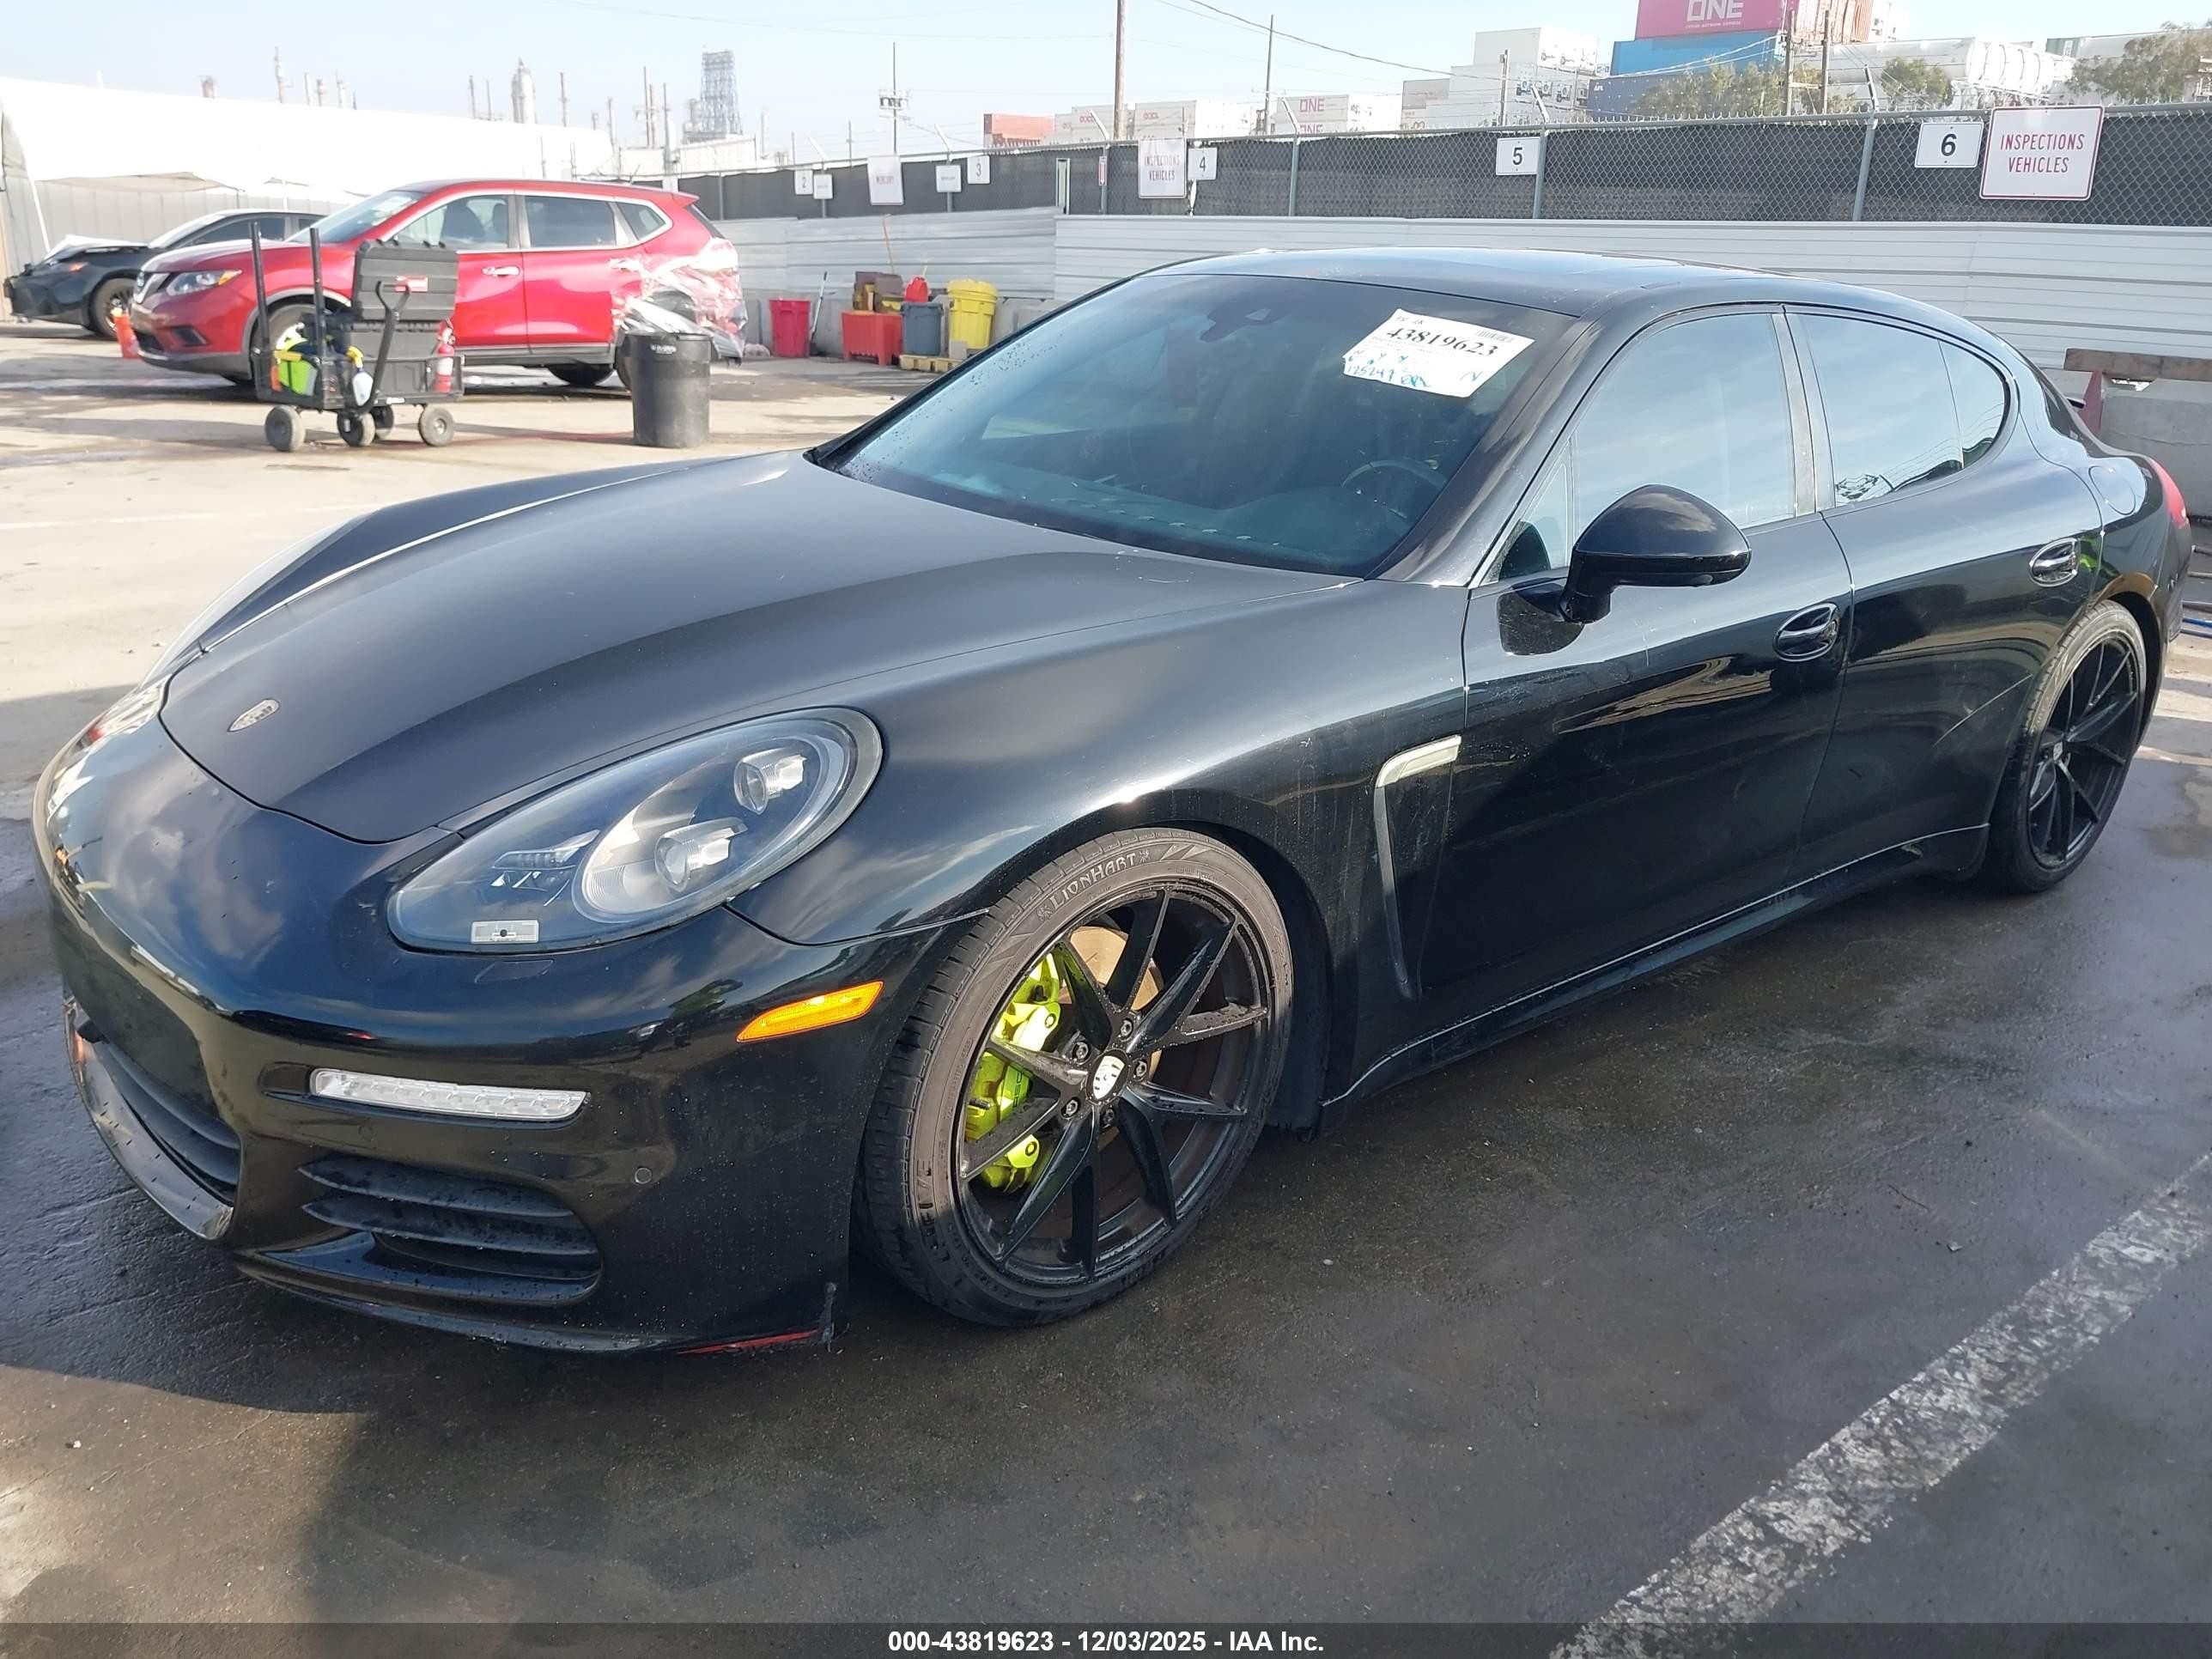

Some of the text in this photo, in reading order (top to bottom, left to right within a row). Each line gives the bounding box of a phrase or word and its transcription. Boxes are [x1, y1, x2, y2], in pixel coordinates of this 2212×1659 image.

[1686, 0, 1744, 21] ONE
[1299, 98, 1325, 112] ONE
[1941, 133, 1957, 156] 6
[2000, 133, 2086, 150] INSPECTIONS
[1144, 155, 1181, 167] INSPECTIONS
[1199, 156, 1206, 173] 4
[1512, 147, 1523, 165] 5
[975, 163, 981, 177] 3
[2008, 157, 2070, 173] VEHICLES
[802, 176, 807, 189] 2
[1149, 170, 1176, 181] VEHICLES
[1386, 327, 1498, 356] 43819623
[1049, 853, 1136, 909] LIONHART
